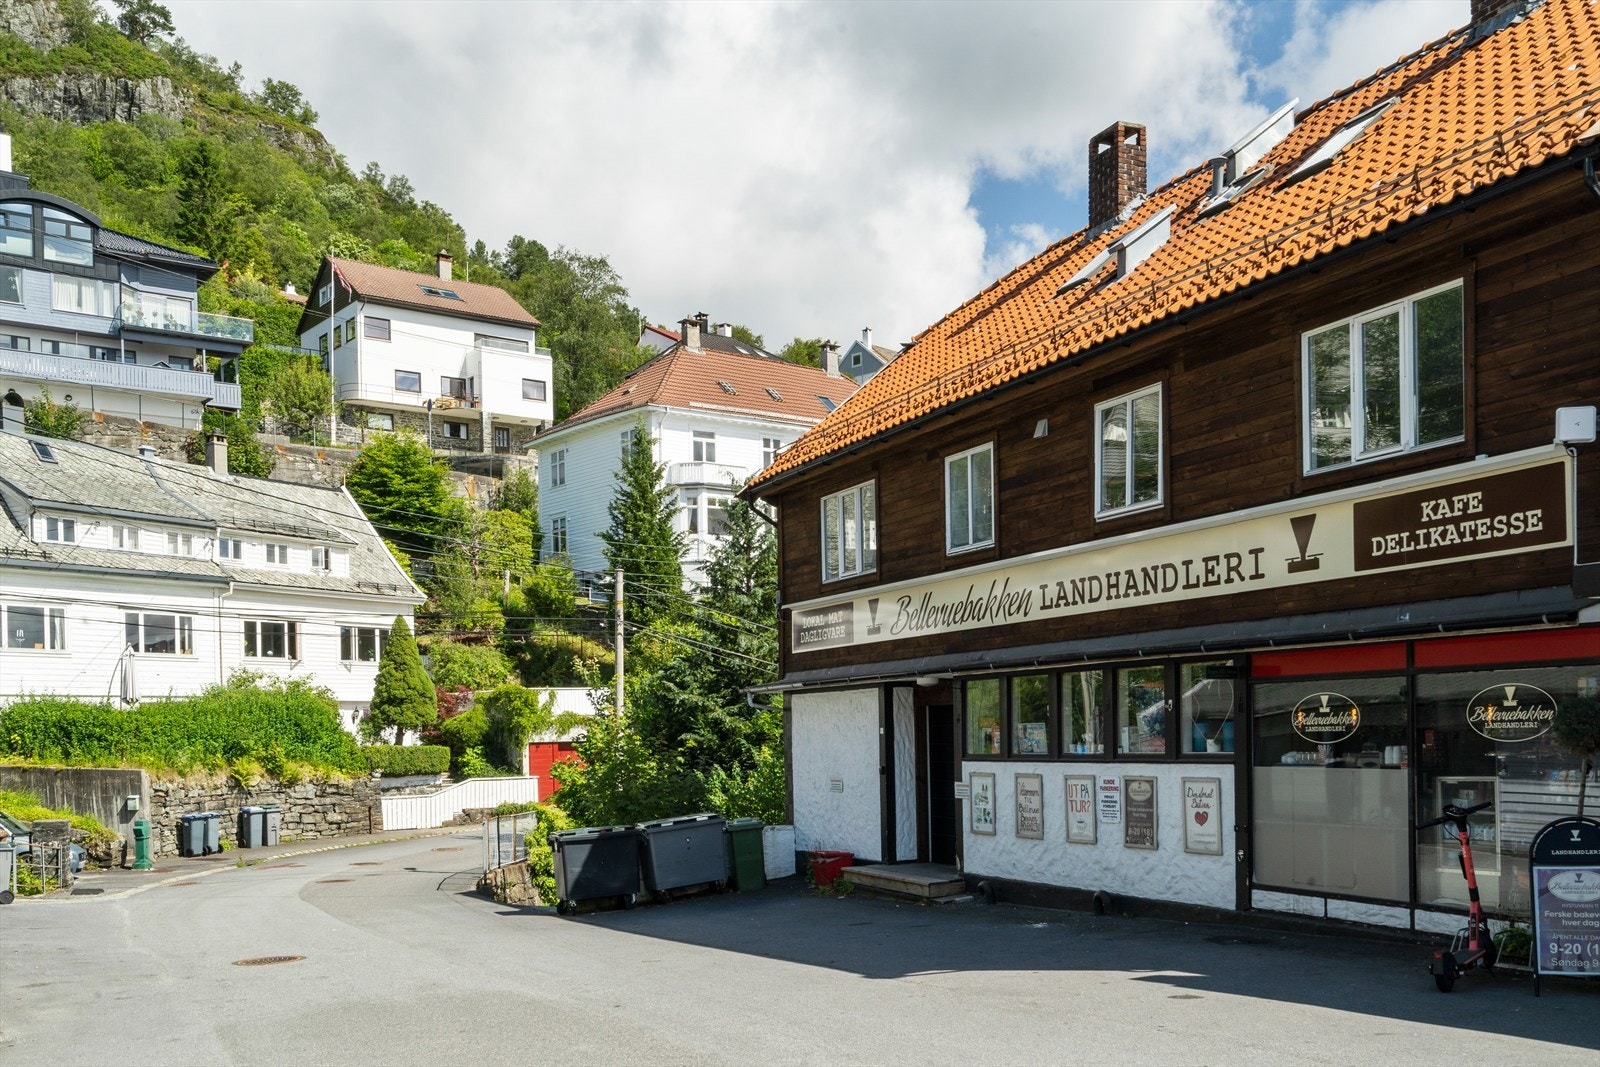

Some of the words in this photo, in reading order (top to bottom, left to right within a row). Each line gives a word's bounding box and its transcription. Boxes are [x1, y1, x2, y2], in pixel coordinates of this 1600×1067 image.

[1421, 491, 1483, 523] KAFE
[1371, 508, 1543, 557] DELIKATESSE
[890, 577, 1033, 635] Bellevuebakken
[1039, 547, 1266, 611] LANDHANDLERI
[802, 614, 825, 629] LOKAL
[828, 611, 843, 625] MAT
[800, 625, 846, 643] DAGLIGVARE
[1470, 704, 1554, 721] Bellevuebakken
[1484, 721, 1538, 729] LANDHANDLERI
[1067, 783, 1079, 798] UT
[1080, 783, 1090, 798] PÅ
[1069, 799, 1091, 813] TUR?
[1544, 910, 1572, 918] Ferske
[1573, 910, 1600, 918] bakev
[1582, 919, 1599, 928] dag
[1549, 942, 1582, 955] 9-20
[1587, 942, 1600, 957] (1
[1551, 957, 1590, 969] Søndag
